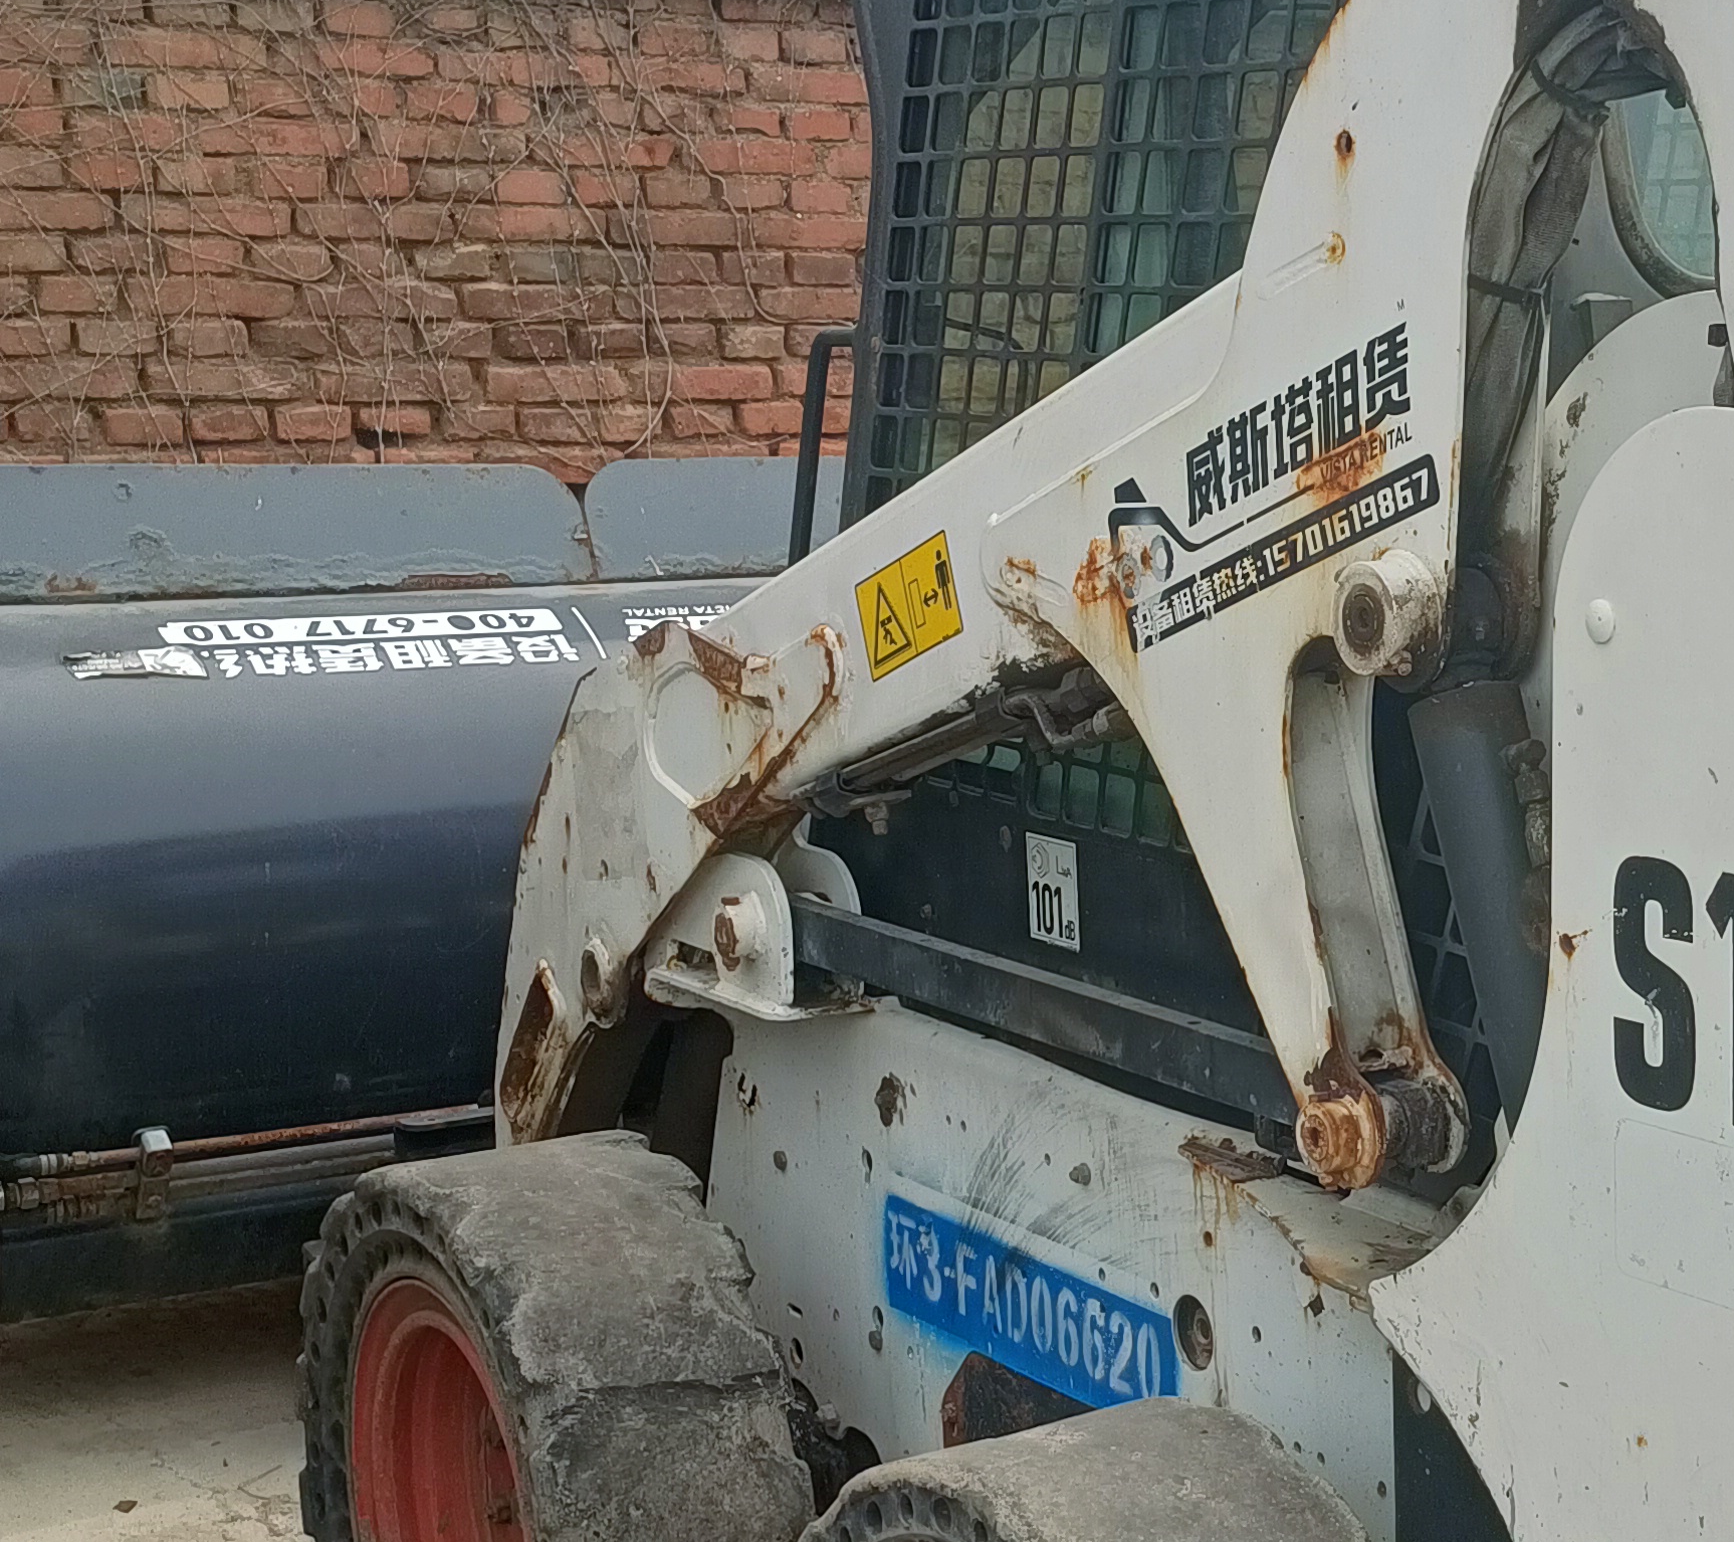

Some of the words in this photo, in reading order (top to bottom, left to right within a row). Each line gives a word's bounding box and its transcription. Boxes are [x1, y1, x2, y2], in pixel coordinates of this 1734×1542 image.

[1186, 321, 1411, 527] 威斯塔租赁
[1319, 451, 1358, 481] VISTA
[1360, 422, 1413, 462] RENTAL
[621, 608, 690, 617] RENTAL
[1032, 880, 1063, 939] 101
[1064, 919, 1076, 941] dB
